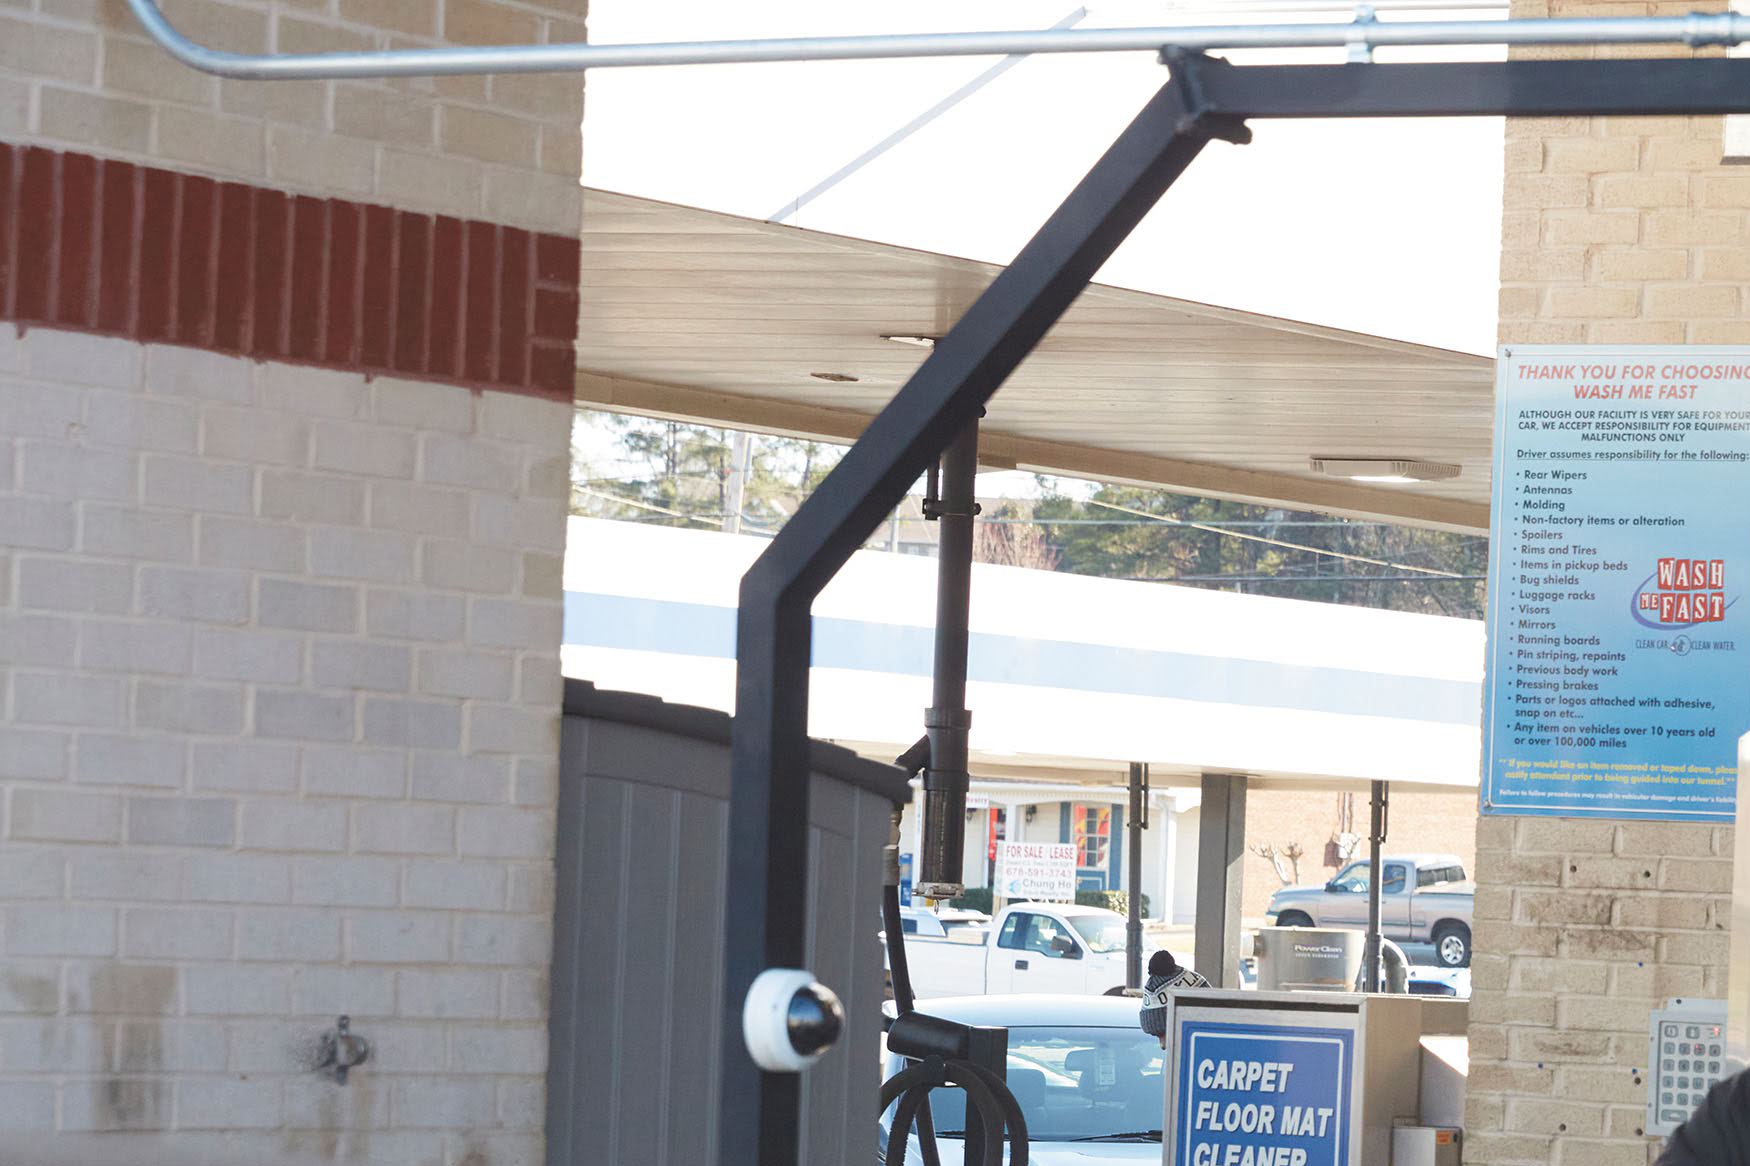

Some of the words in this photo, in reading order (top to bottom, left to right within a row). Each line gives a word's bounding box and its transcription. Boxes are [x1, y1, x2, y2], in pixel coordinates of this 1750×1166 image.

[1518, 365, 1576, 379] THANK
[1581, 365, 1618, 379] YOU
[1622, 365, 1657, 379] FOR
[1573, 385, 1623, 399] WASH
[1628, 385, 1655, 399] ME
[1658, 385, 1697, 399] FAST
[1519, 410, 1571, 419] ALTHOUGH
[1574, 410, 1596, 419] OUR
[1598, 411, 1637, 419] FACILITY
[1640, 411, 1649, 419] IS
[1651, 411, 1675, 419] VERY
[1678, 411, 1700, 419] SAFE
[1703, 411, 1722, 419] FOR
[1725, 411, 1750, 420] YOUR
[1519, 422, 1539, 431] CAR,
[1542, 422, 1556, 430] WE
[1559, 422, 1592, 430] ACCEPT
[1595, 422, 1670, 431] RESPONSIBILITY
[1673, 422, 1692, 431] FOR
[1695, 422, 1750, 431] EQUIPMENT
[1581, 433, 1656, 442] MALFUNCTIONS
[1659, 433, 1685, 442] ONLY
[1517, 450, 1547, 459] Driver
[1550, 450, 1592, 459] assumes
[1594, 450, 1661, 461] responsibility
[1664, 450, 1679, 459] for
[1681, 451, 1697, 460] the
[1699, 451, 1750, 462] following:
[1524, 471, 1548, 480] Rear
[1551, 471, 1587, 481] Wipers
[1523, 486, 1573, 495] Antennas
[1523, 501, 1565, 511] Molding
[1522, 516, 1584, 526] Non-factory
[1587, 517, 1616, 526] items
[1619, 518, 1630, 526] or
[1633, 517, 1685, 526] alteration
[1522, 530, 1563, 541] Spoilers
[1521, 545, 1545, 555] Rims
[1550, 546, 1569, 555] and
[1573, 546, 1597, 555] Tires
[1520, 561, 1549, 570] Items
[1552, 561, 1561, 570] in
[1564, 561, 1600, 573] pickup
[1603, 561, 1628, 571] beds
[1658, 559, 1724, 590] WASH
[1520, 575, 1540, 587] Bug
[1543, 576, 1579, 585] shields
[1520, 591, 1564, 601] Luggage
[1568, 591, 1595, 600] racks
[1519, 605, 1550, 615] Visors
[1641, 594, 1658, 609] ME
[1661, 594, 1724, 621] FAST
[1519, 620, 1556, 630] Mirrors
[1518, 635, 1560, 646] Running
[1564, 636, 1600, 645] boards
[1636, 640, 1655, 648] CLEAN
[1691, 641, 1710, 649] CLEAN
[1517, 650, 1533, 659] Pin
[1536, 650, 1580, 662] striping,
[1583, 651, 1626, 662] repaints
[1517, 665, 1560, 675] Previous
[1564, 666, 1589, 677] body
[1591, 666, 1618, 676] work
[1516, 680, 1559, 691] Pressing
[1563, 681, 1599, 691] brakes
[1516, 695, 1542, 704] Parts
[1545, 697, 1556, 705] or
[1559, 696, 1587, 708] logos
[1590, 697, 1635, 707] attached
[1639, 697, 1661, 708] with
[1664, 699, 1715, 710] adhesive,
[1515, 710, 1541, 719] snap
[1543, 709, 1557, 717] on
[1559, 709, 1584, 718] etc...
[1514, 723, 1534, 735] Any
[1537, 724, 1560, 733] item
[1563, 725, 1576, 733] on
[1579, 725, 1620, 735] vehicles
[1624, 727, 1649, 736] over
[1651, 726, 1663, 736] 10
[1666, 728, 1696, 739] years
[1698, 728, 1715, 737] old
[1514, 737, 1525, 745] or
[1555, 737, 1596, 747] 100,000
[1600, 738, 1627, 748] miles
[1006, 846, 1022, 857] FOR
[1024, 846, 1043, 858] SALE
[1050, 847, 1074, 859] LEASE
[1197, 1059, 1294, 1093] CARPET
[1195, 1101, 1274, 1134] FLOOR
[1280, 1105, 1333, 1137] MAT
